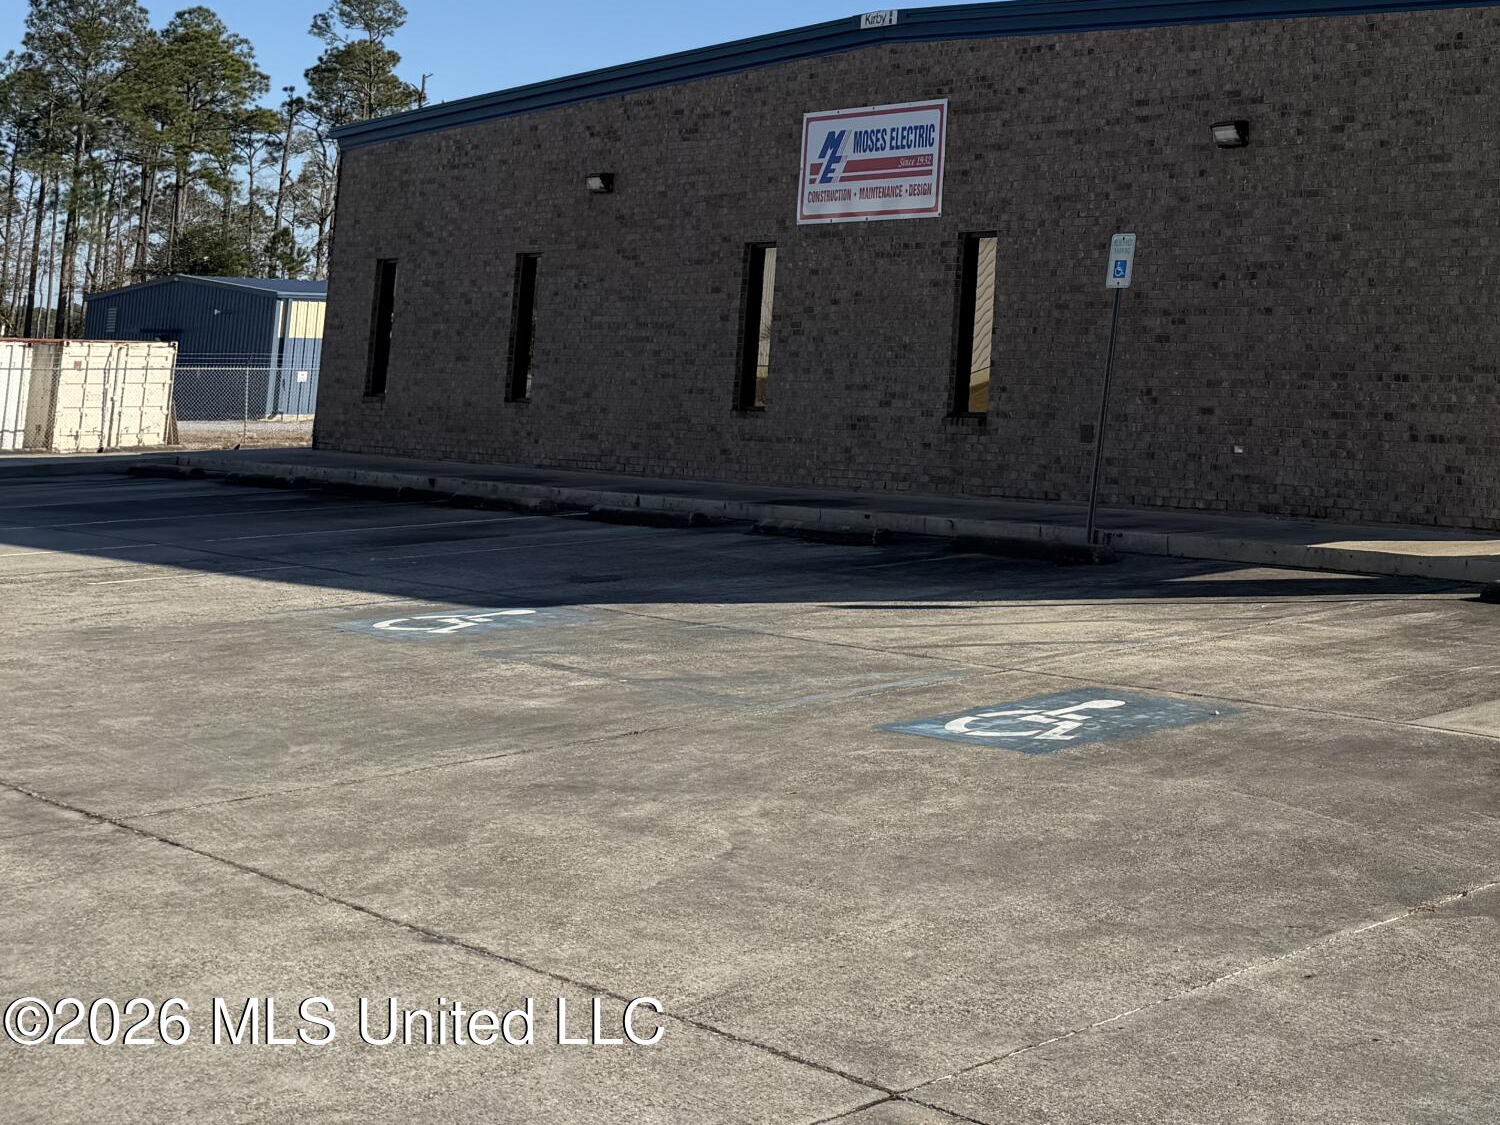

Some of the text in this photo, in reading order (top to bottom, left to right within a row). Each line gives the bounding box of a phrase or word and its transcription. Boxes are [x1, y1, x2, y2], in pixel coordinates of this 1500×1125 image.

[865, 12, 887, 25] Kirby
[853, 124, 936, 154] MOSES ELECTRIC
[898, 157, 915, 168] Since
[808, 183, 932, 203] CONSTRUCTION MAINTENANCE DESIGN
